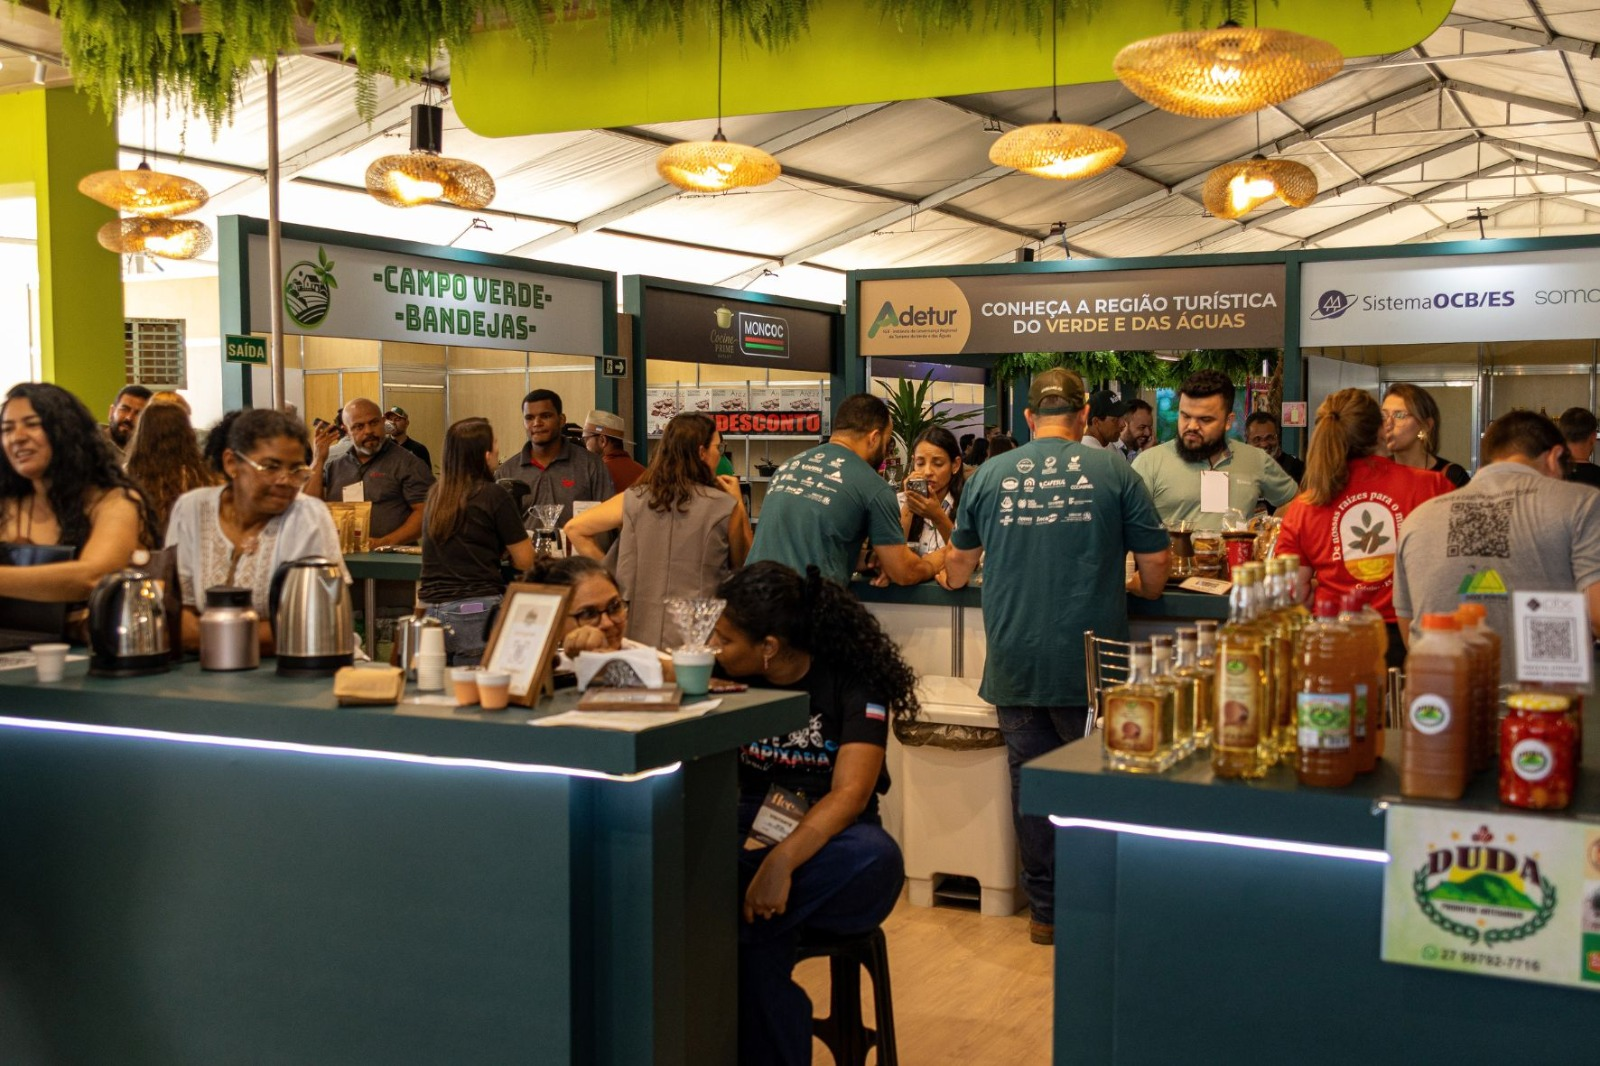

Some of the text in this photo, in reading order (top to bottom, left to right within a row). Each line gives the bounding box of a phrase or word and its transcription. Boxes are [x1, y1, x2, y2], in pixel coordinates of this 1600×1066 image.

[981, 291, 1277, 318] CONHEÇA A REGIÃO TURÍSTICA
[744, 320, 784, 338] MONCOC
[1013, 311, 1246, 334] DO VERDE E DAS ÁGUAS
[228, 341, 266, 359] SAÍDA
[715, 413, 820, 433] DESCONTO
[1369, 491, 1393, 504] para
[1331, 511, 1340, 544] nossas
[1332, 545, 1341, 561] De
[1428, 845, 1541, 885] DUDA
